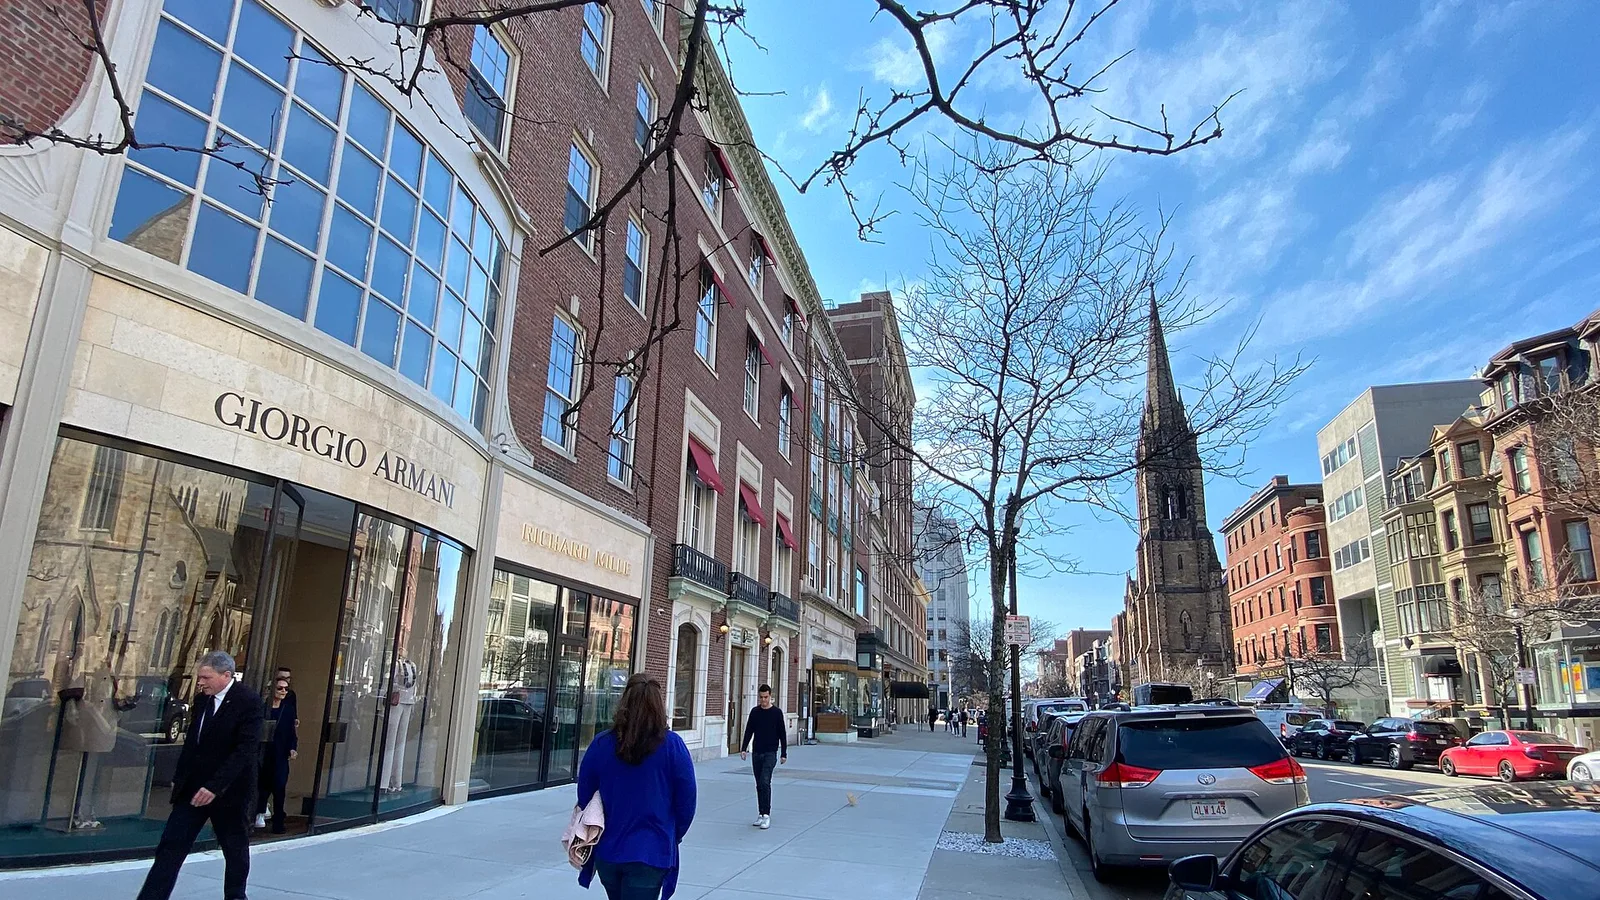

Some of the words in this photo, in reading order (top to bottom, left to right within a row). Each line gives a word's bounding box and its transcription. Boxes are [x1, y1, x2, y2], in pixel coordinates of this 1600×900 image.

[214, 392, 367, 468] GIORGIO
[372, 451, 456, 509] ARMANI
[521, 522, 591, 562] RICHARD
[595, 549, 632, 576] MILLE
